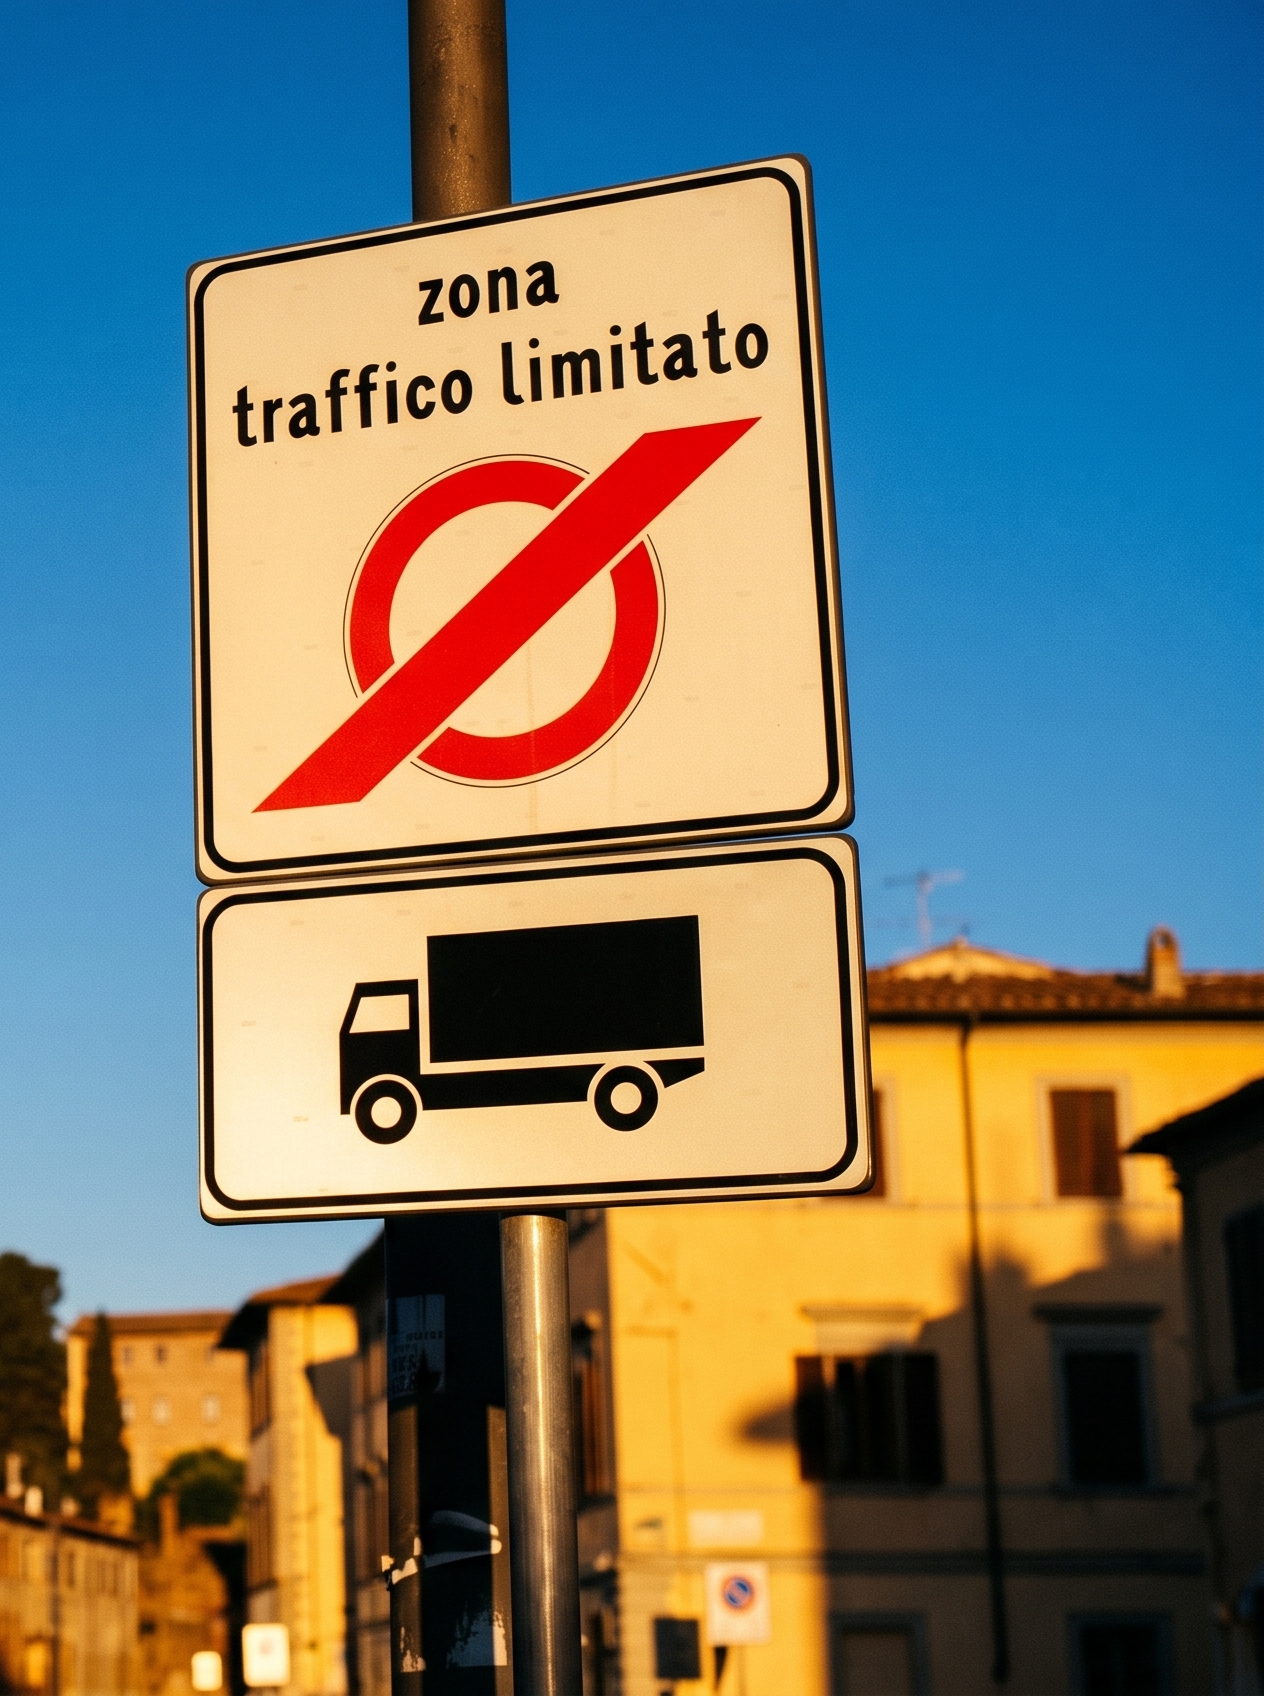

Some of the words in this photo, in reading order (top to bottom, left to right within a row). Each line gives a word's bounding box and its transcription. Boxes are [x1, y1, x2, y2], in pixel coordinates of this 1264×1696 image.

[418, 260, 560, 326] zona
[232, 361, 473, 447] traffico
[501, 309, 769, 406] limitato
